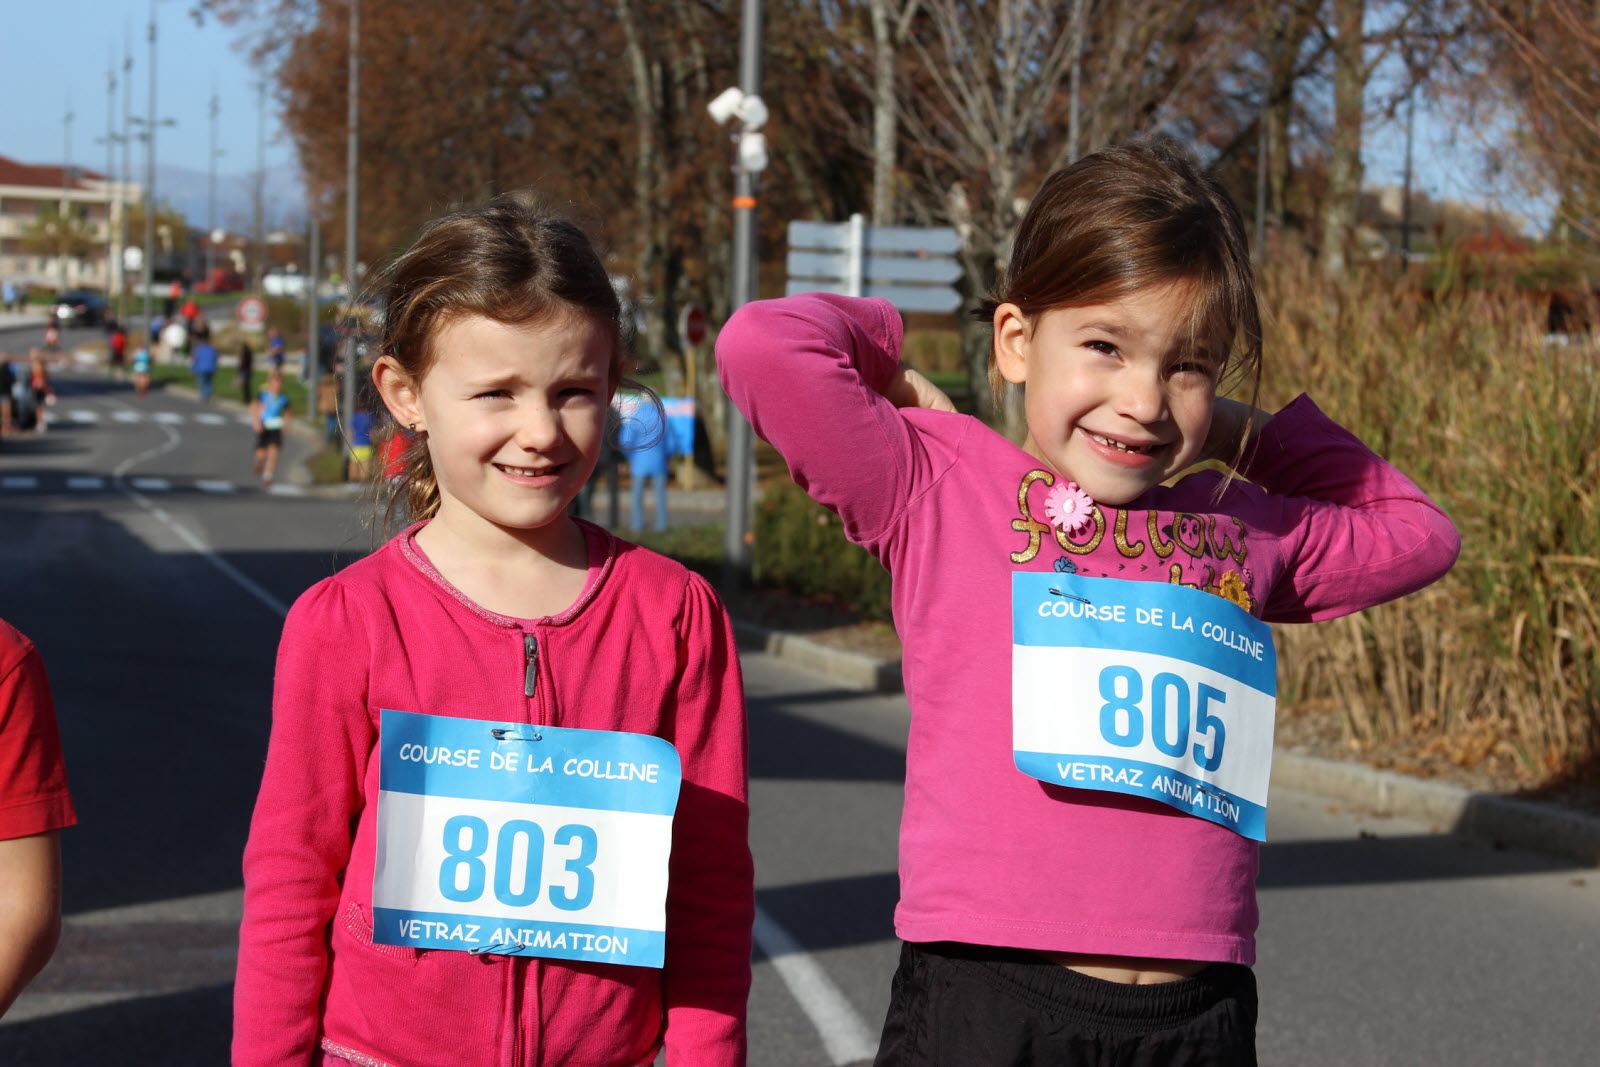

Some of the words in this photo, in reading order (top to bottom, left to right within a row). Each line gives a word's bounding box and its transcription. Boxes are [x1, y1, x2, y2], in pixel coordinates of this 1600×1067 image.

[1038, 601, 1126, 622] COURSE
[1135, 608, 1163, 627] DE
[1171, 612, 1194, 633] LA
[1201, 622, 1264, 661] COLLINE
[1099, 665, 1227, 772] 805
[399, 743, 481, 769] COURSE
[490, 752, 519, 772] DE
[527, 754, 554, 774] LA
[563, 758, 660, 784] COLLINE
[1056, 762, 1143, 788] VETRAZ
[1151, 775, 1240, 824] ANIMATION
[438, 814, 599, 912] 803
[398, 919, 481, 943] VETRAZ
[489, 927, 628, 955] ANIMATION
